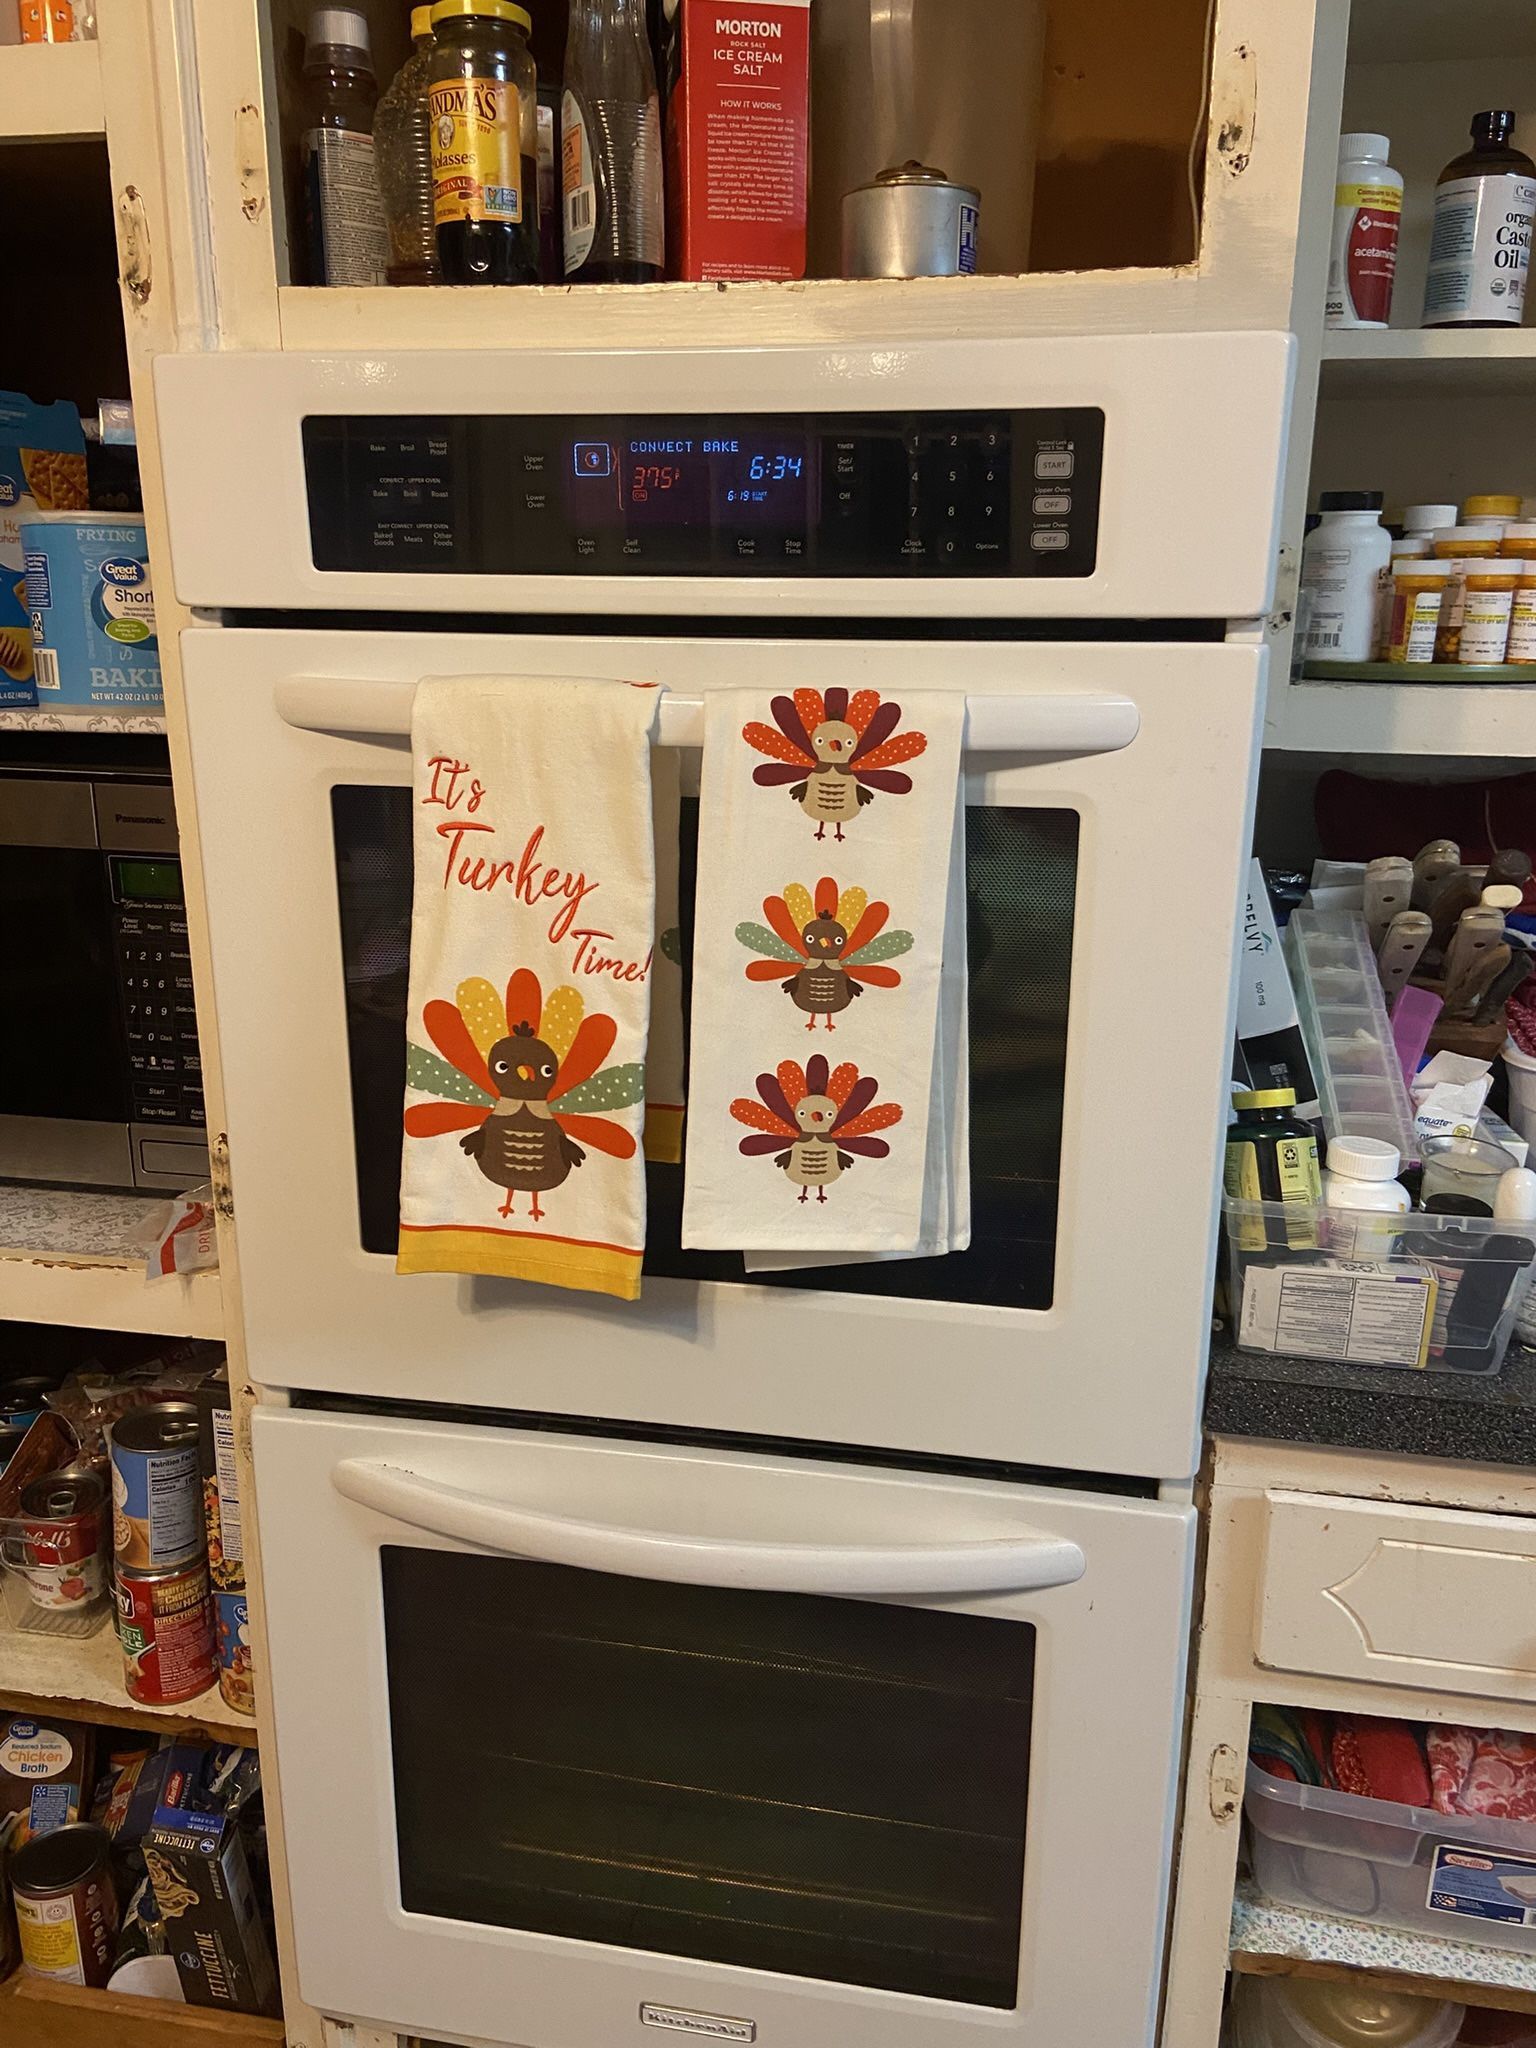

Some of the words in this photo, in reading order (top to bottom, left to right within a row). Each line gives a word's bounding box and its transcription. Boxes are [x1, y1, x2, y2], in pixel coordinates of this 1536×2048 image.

[716, 19, 781, 38] MORTON
[714, 49, 734, 60] ICE
[738, 50, 782, 64] CREAM
[733, 64, 763, 76] SALT
[752, 101, 782, 110] WORKS
[1494, 250, 1520, 268] Oil
[914, 436, 919, 446] 1
[951, 436, 957, 446] 2
[989, 435, 995, 445] 3
[630, 441, 692, 452] CONVECT
[703, 441, 739, 452] BAKE
[750, 456, 802, 480] 6:34
[912, 473, 919, 482] 4
[950, 472, 956, 481] 5
[987, 472, 994, 480] 6
[912, 507, 917, 516] 7
[948, 507, 955, 516] 8
[986, 506, 992, 516] 9
[76, 528, 136, 542] FRYING
[785, 540, 801, 548] Stop
[946, 542, 953, 552] 0
[105, 564, 137, 576] Great
[422, 756, 486, 813] It's
[115, 814, 166, 824] Panasonic
[436, 821, 599, 944] Turkey
[126, 951, 130, 959] 1
[140, 952, 146, 960] 2
[155, 952, 162, 961] 3
[570, 928, 654, 982] Time!
[142, 979, 148, 987] 5
[158, 980, 164, 988] 6
[1256, 981, 1264, 994] 100
[130, 1005, 136, 1014] 7
[145, 1006, 152, 1014] 8
[161, 1007, 167, 1015] 9
[148, 1033, 154, 1041] 0
[142, 1107, 176, 1116] Stop/Reset
[1418, 1116, 1449, 1127] equate
[151, 1458, 180, 1468] Nutrition
[152, 1484, 176, 1492] Calories
[13, 1724, 34, 1732] Great
[8, 1751, 63, 1762] Chicken
[21, 1764, 48, 1773] Broth
[166, 1772, 181, 1805] Barilla
[154, 1833, 195, 1850] FETTUCCINE
[1450, 1855, 1492, 1869] Sterilite
[194, 1930, 230, 1999] FETTUCCINE
[648, 2012, 746, 2036] KitchenAid
